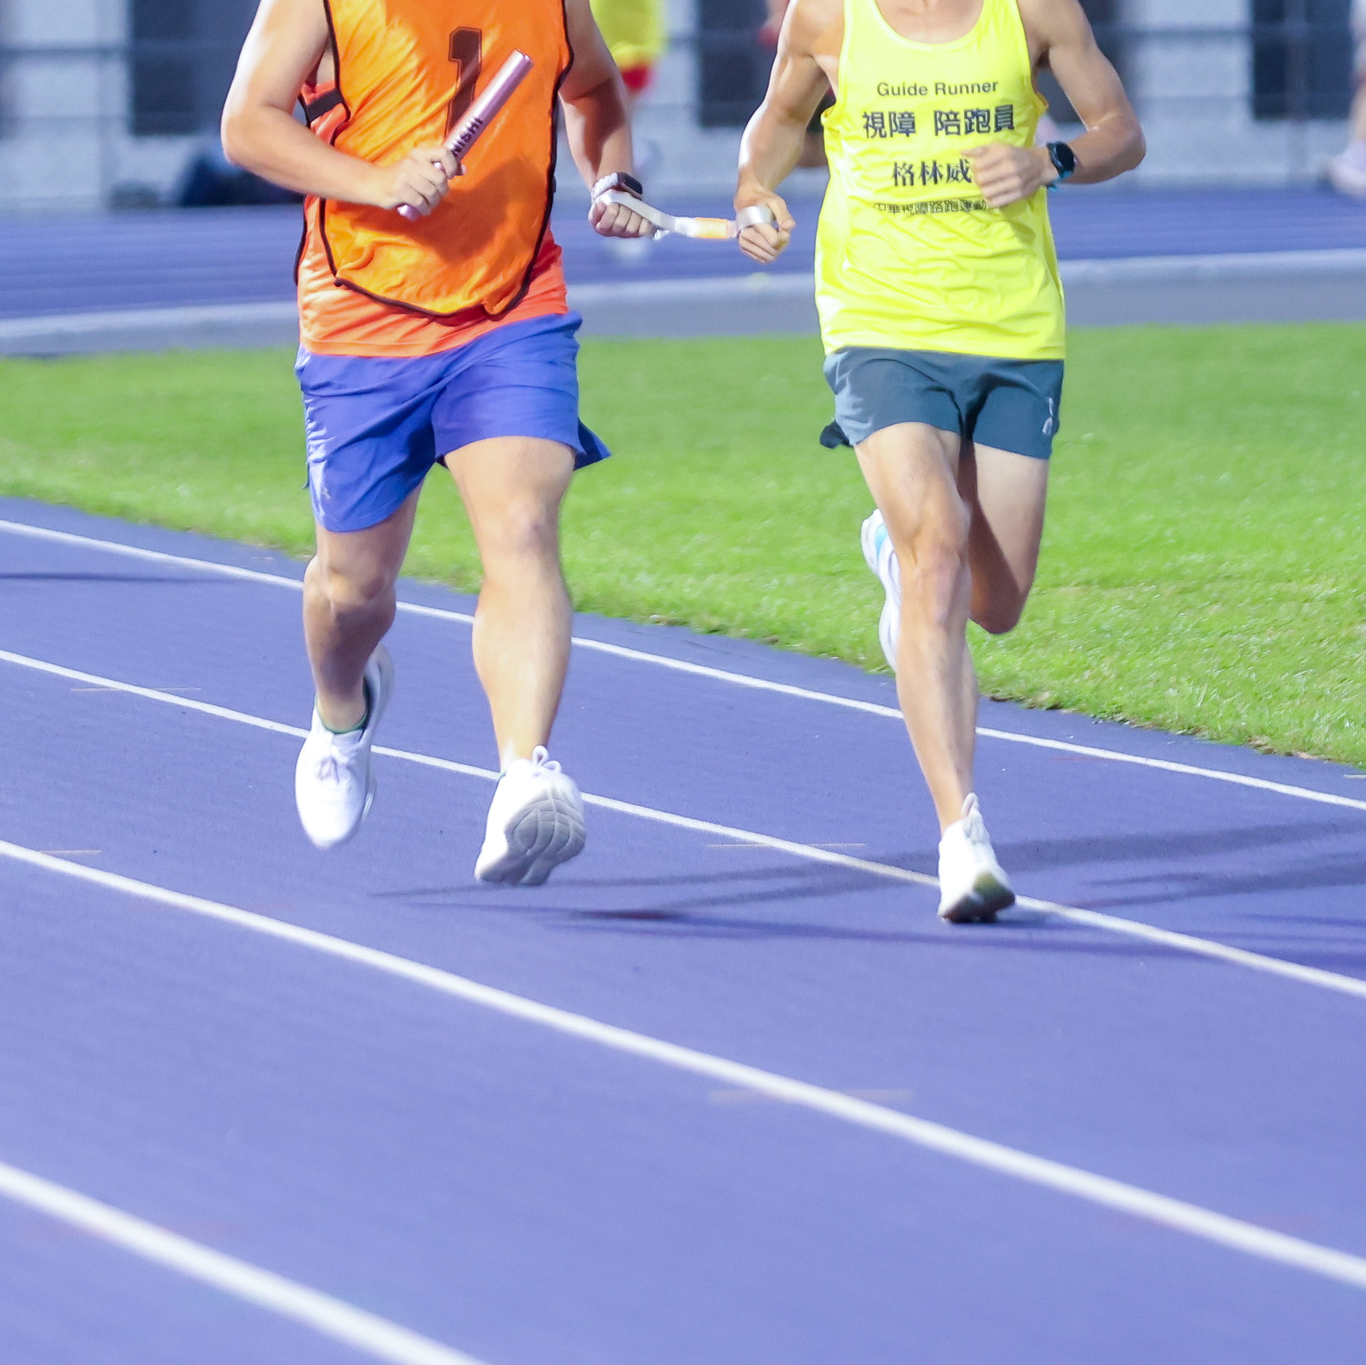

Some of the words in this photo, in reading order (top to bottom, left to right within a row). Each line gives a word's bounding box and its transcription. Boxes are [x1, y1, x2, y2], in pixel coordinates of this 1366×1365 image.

[447, 27, 482, 140] 1
[877, 82, 928, 97] Guide
[935, 81, 999, 96] Runner
[452, 117, 484, 157] NISHI
[863, 111, 916, 138] 視障
[934, 104, 1015, 136] 陪跑員
